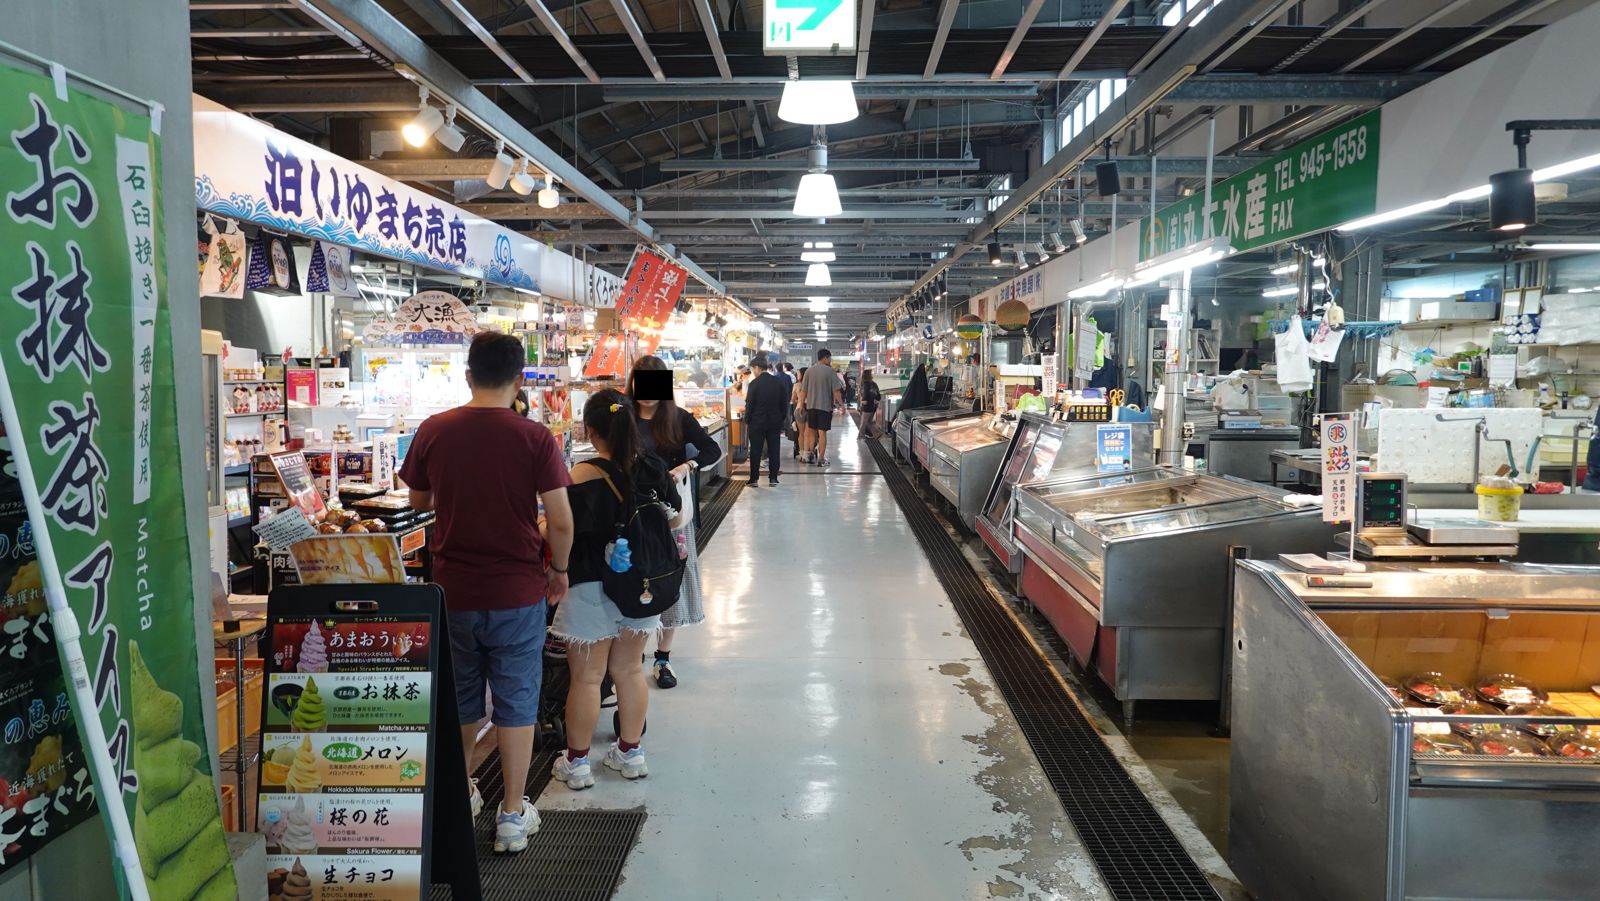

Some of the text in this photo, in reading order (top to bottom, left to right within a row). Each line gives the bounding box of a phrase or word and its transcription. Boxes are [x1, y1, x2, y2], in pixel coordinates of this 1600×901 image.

[1274, 125, 1367, 193] TEL 945-1558
[265, 139, 467, 264] 泊いゆまち売店
[1271, 198, 1295, 234] FAX
[411, 302, 461, 325] 大漁
[136, 517, 154, 631] Matcha
[361, 682, 420, 701] お抹茶
[327, 745, 409, 761] 北海道 メロン
[329, 807, 389, 827] 桜の花
[346, 847, 370, 855] Sakura
[371, 847, 393, 855] Flower
[323, 864, 394, 884] 生チョコ
